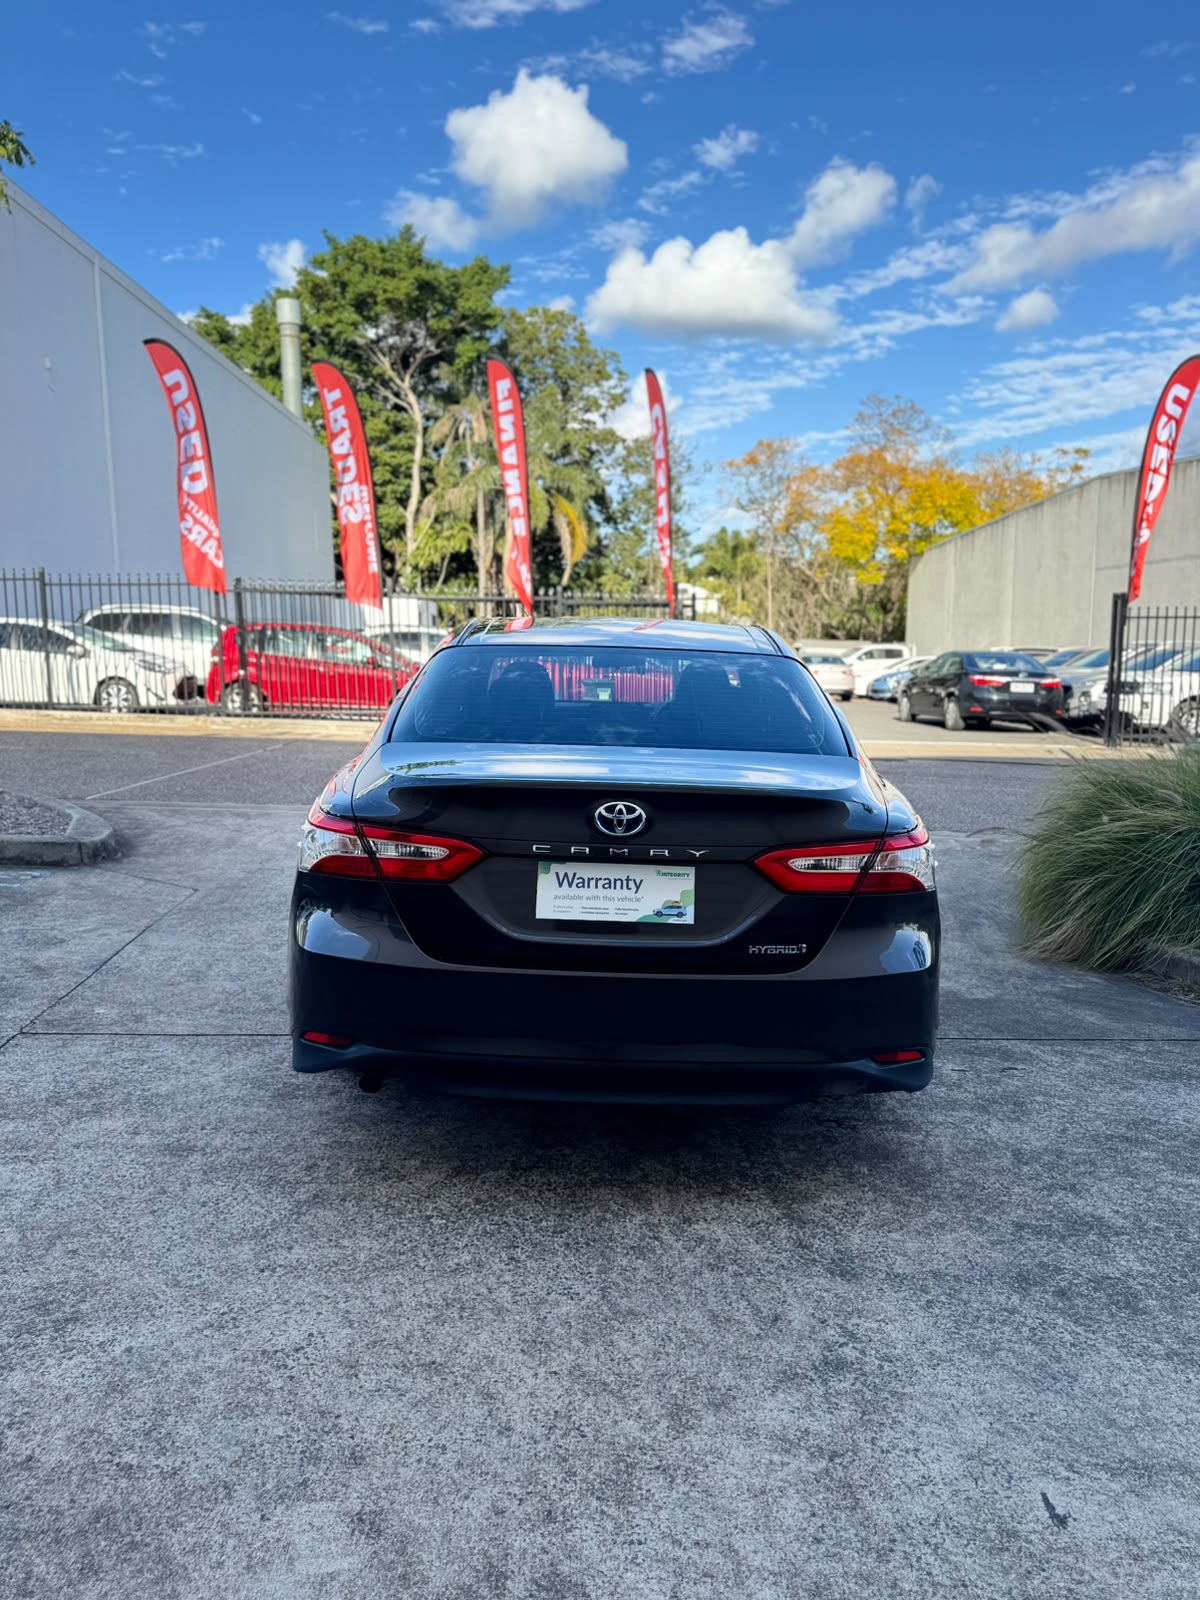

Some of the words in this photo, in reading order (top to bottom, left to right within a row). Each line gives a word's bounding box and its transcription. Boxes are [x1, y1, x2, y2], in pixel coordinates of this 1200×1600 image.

[1144, 383, 1190, 502] USED
[532, 844, 710, 858] CAMRY
[555, 871, 644, 894] Warranty
[553, 893, 584, 901] available
[585, 894, 601, 902] with
[602, 894, 616, 902] this
[748, 945, 798, 954] HYBRID
